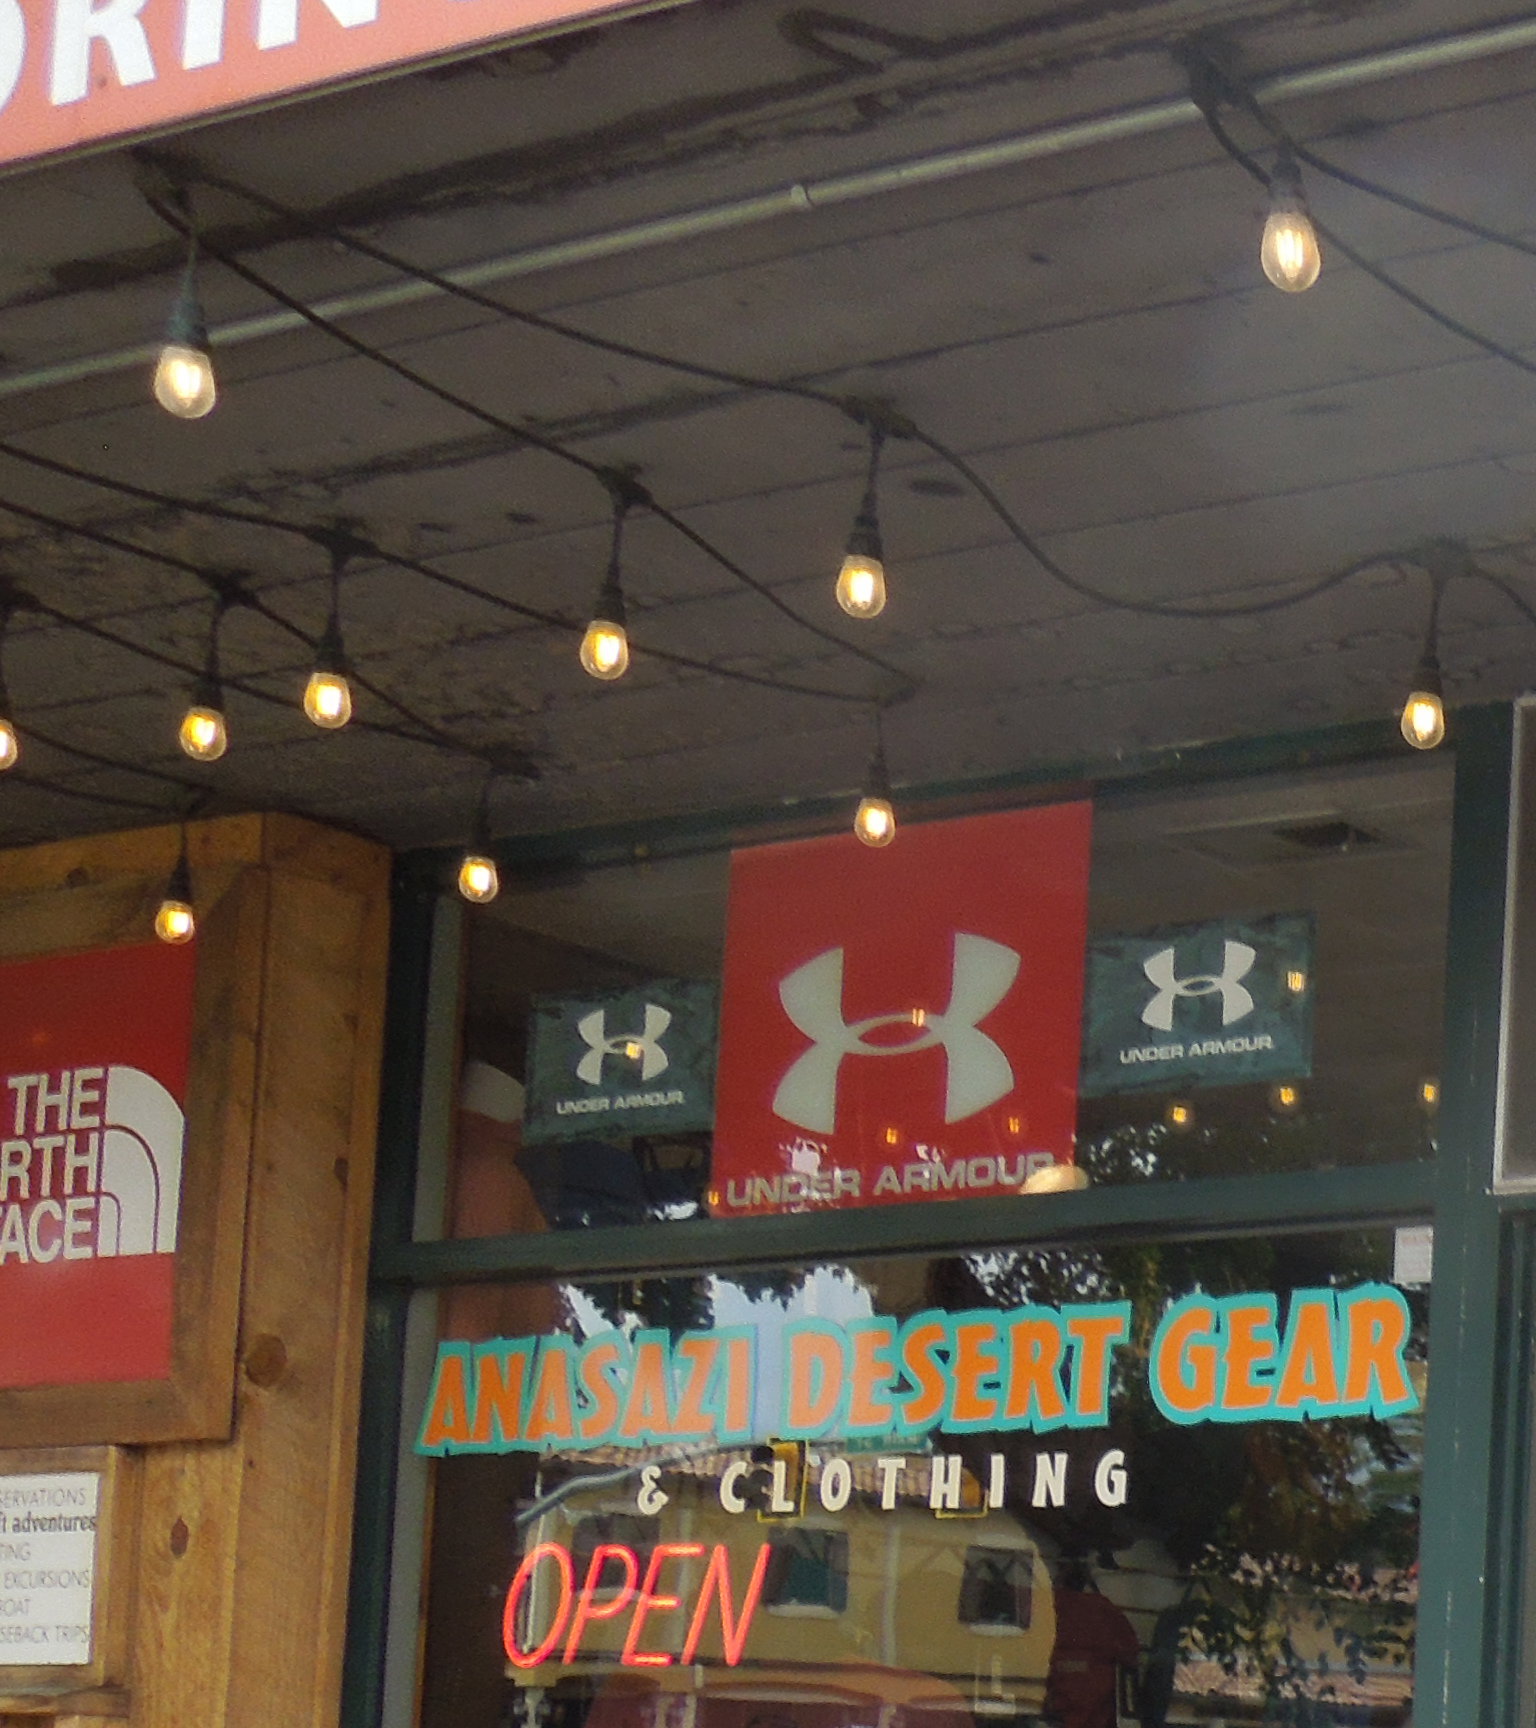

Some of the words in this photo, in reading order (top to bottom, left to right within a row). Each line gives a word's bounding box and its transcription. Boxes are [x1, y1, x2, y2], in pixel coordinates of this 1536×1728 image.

[1120, 1043, 1184, 1063] UNDER
[1189, 1035, 1273, 1058] ARMOUR
[8, 1067, 104, 1136] THE
[556, 1097, 610, 1115] UNDER
[614, 1091, 684, 1111] ARMOUR
[727, 1166, 861, 1207] UNDER
[873, 1152, 1055, 1196] ARMOUR
[0, 1196, 96, 1266] ACE
[415, 1324, 758, 1457] ANASAZI
[776, 1300, 1133, 1444] DESERT
[1147, 1280, 1419, 1425] GEAR
[636, 1467, 668, 1515] &
[718, 1450, 1129, 1516] CLOTHING
[12, 1511, 97, 1534] adventures
[503, 1542, 771, 1668] OPEN
